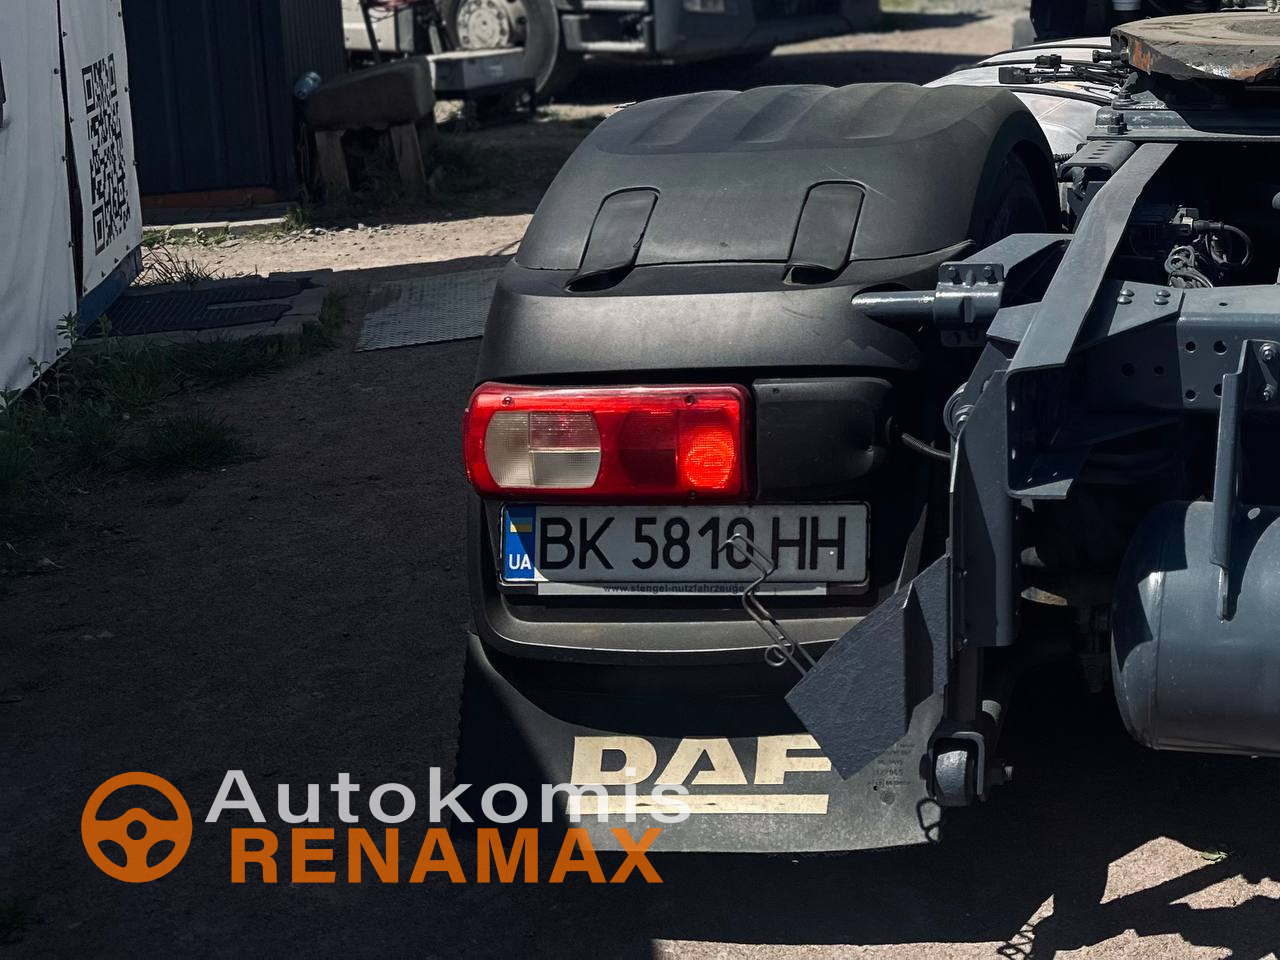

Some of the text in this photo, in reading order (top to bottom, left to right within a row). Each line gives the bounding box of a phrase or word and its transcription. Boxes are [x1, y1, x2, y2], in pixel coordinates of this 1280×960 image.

[540, 517, 847, 571] BK 5810 HH
[509, 554, 532, 571] UA
[602, 583, 760, 595] www.stengel-nutzfahrzeugee
[571, 734, 832, 785] DAF
